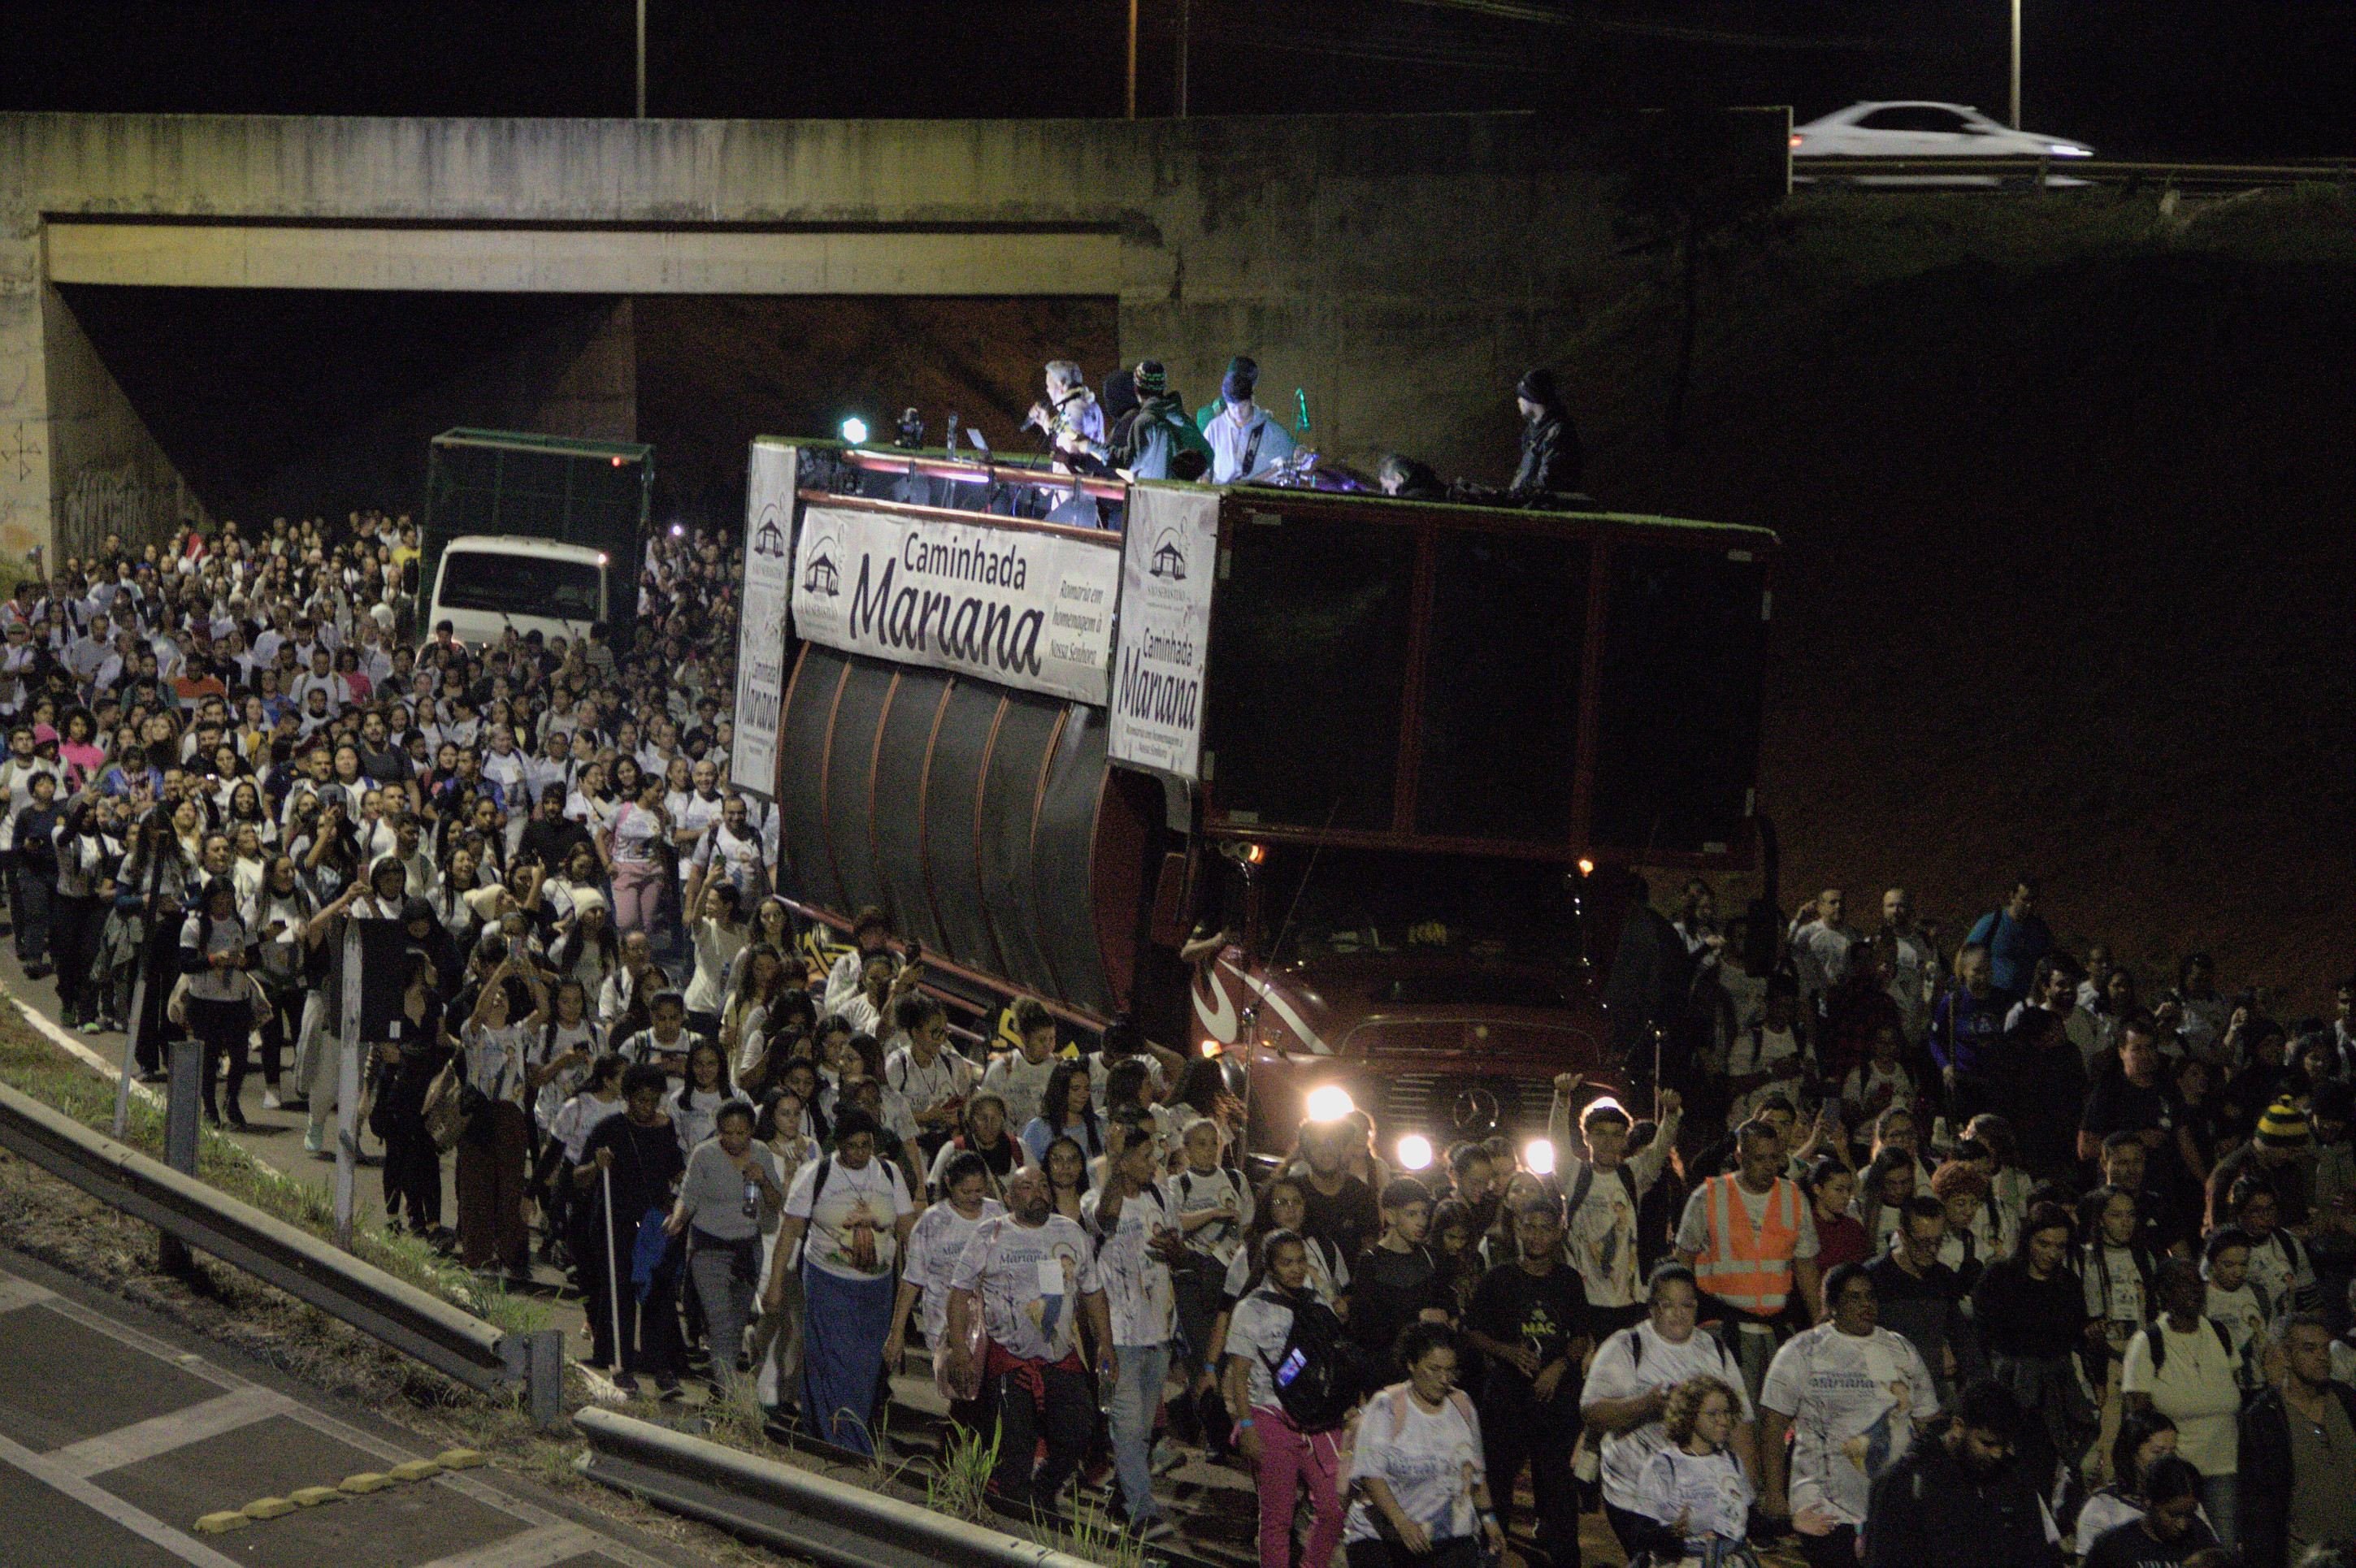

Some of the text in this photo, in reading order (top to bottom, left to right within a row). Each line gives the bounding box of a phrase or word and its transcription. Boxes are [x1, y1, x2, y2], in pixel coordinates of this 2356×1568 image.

[904, 531, 1027, 591] Caminhada
[849, 552, 1045, 678] Mariana
[1143, 627, 1193, 667] Caminhada
[1117, 646, 1198, 730] Mariana
